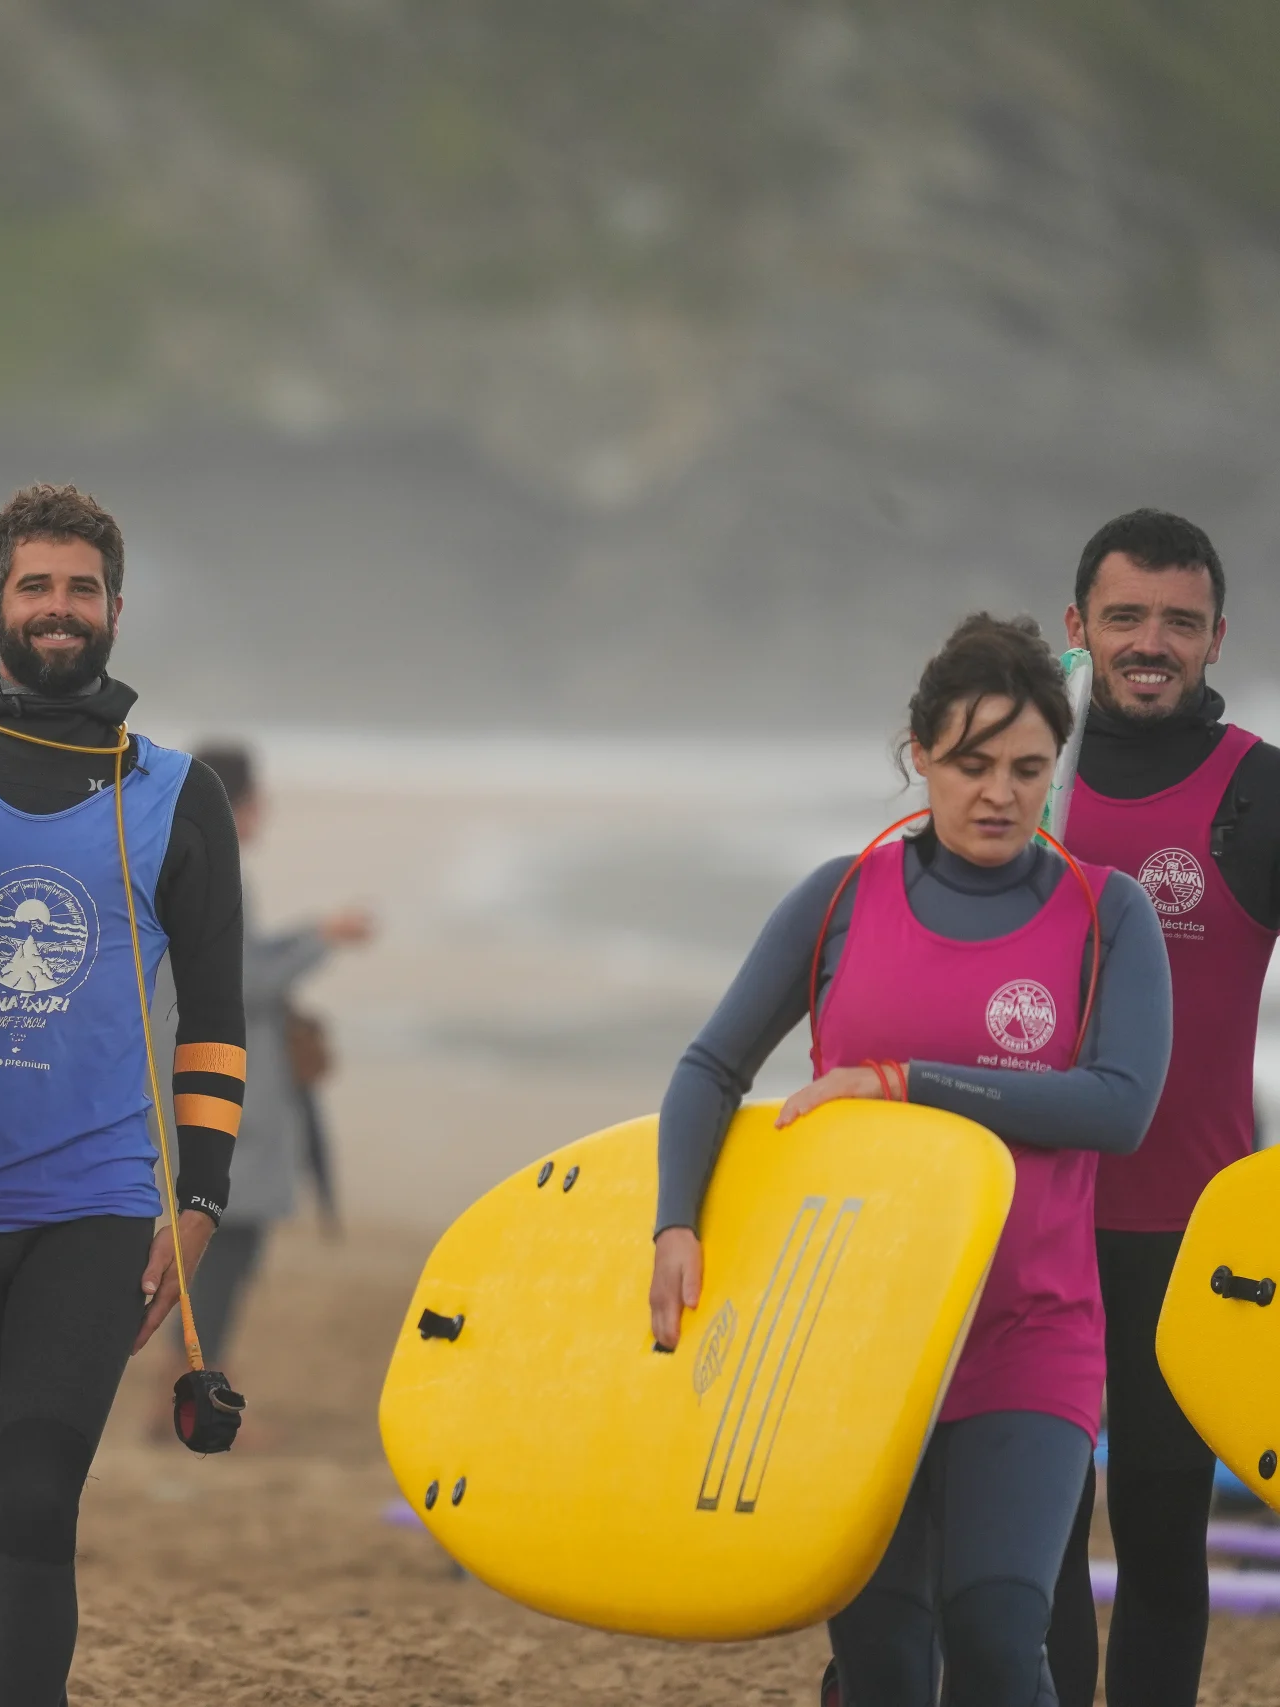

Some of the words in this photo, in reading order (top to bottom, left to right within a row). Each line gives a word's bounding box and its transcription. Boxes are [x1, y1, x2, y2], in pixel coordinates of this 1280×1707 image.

[1160, 919, 1205, 932] léctrica
[4, 1058, 51, 1071] premium
[977, 1055, 999, 1066] red
